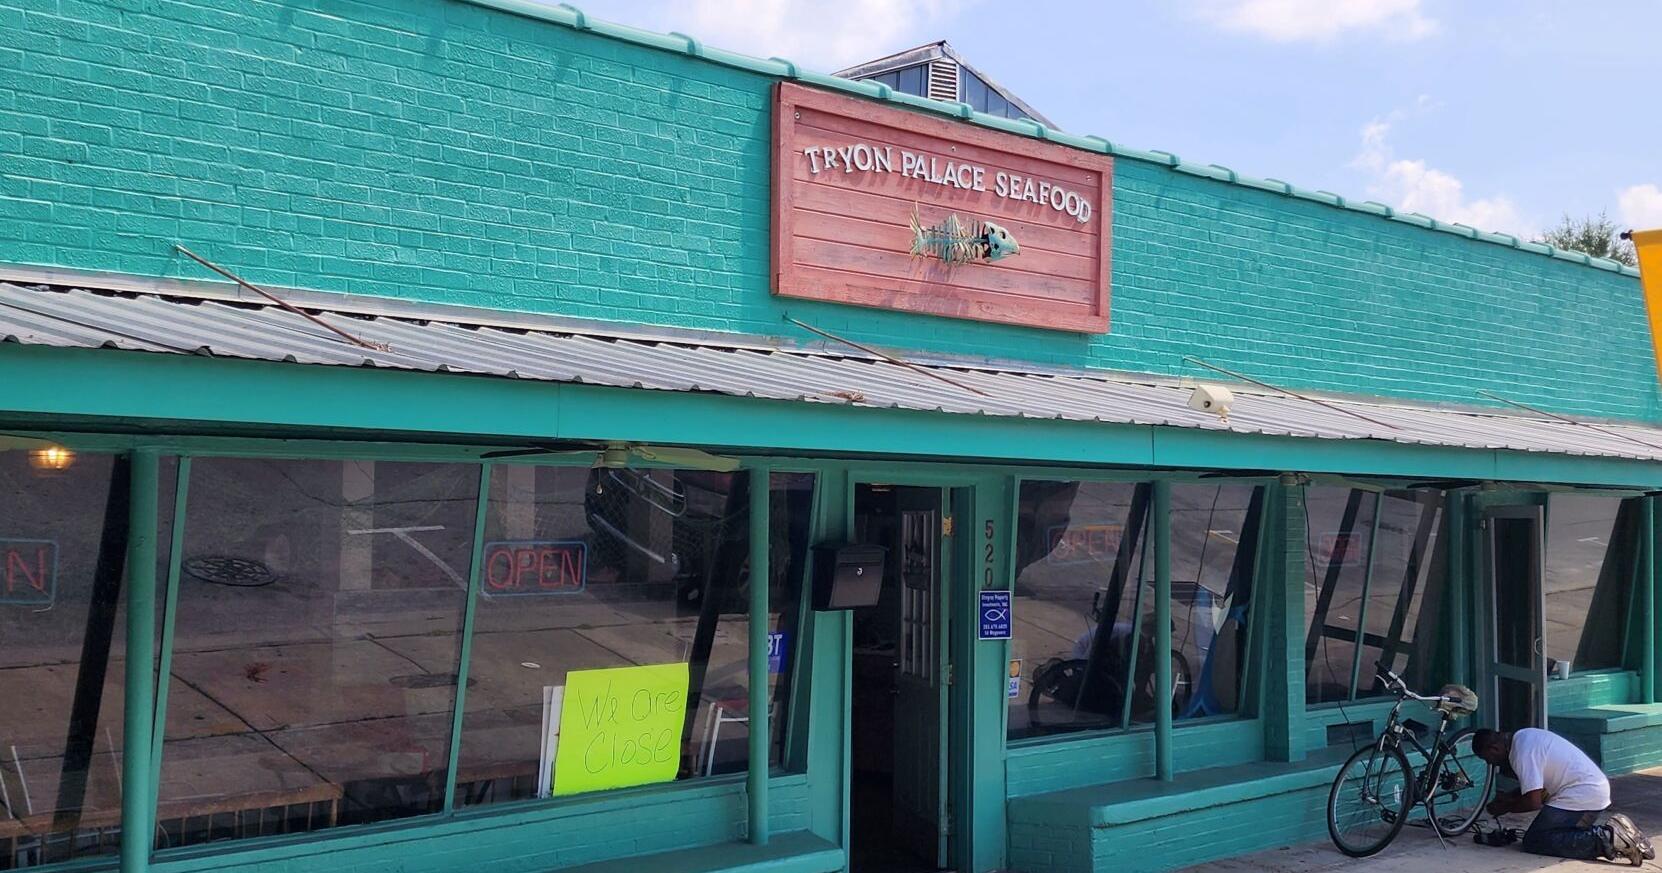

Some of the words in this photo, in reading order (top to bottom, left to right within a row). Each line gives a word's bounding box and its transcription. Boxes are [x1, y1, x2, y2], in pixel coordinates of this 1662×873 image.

[803, 143, 894, 175] TRYON
[900, 151, 987, 193] PALACE
[995, 171, 1092, 225] SEAFOOD
[487, 548, 583, 590] OPEN
[577, 679, 618, 731] We
[584, 728, 673, 774] Close
